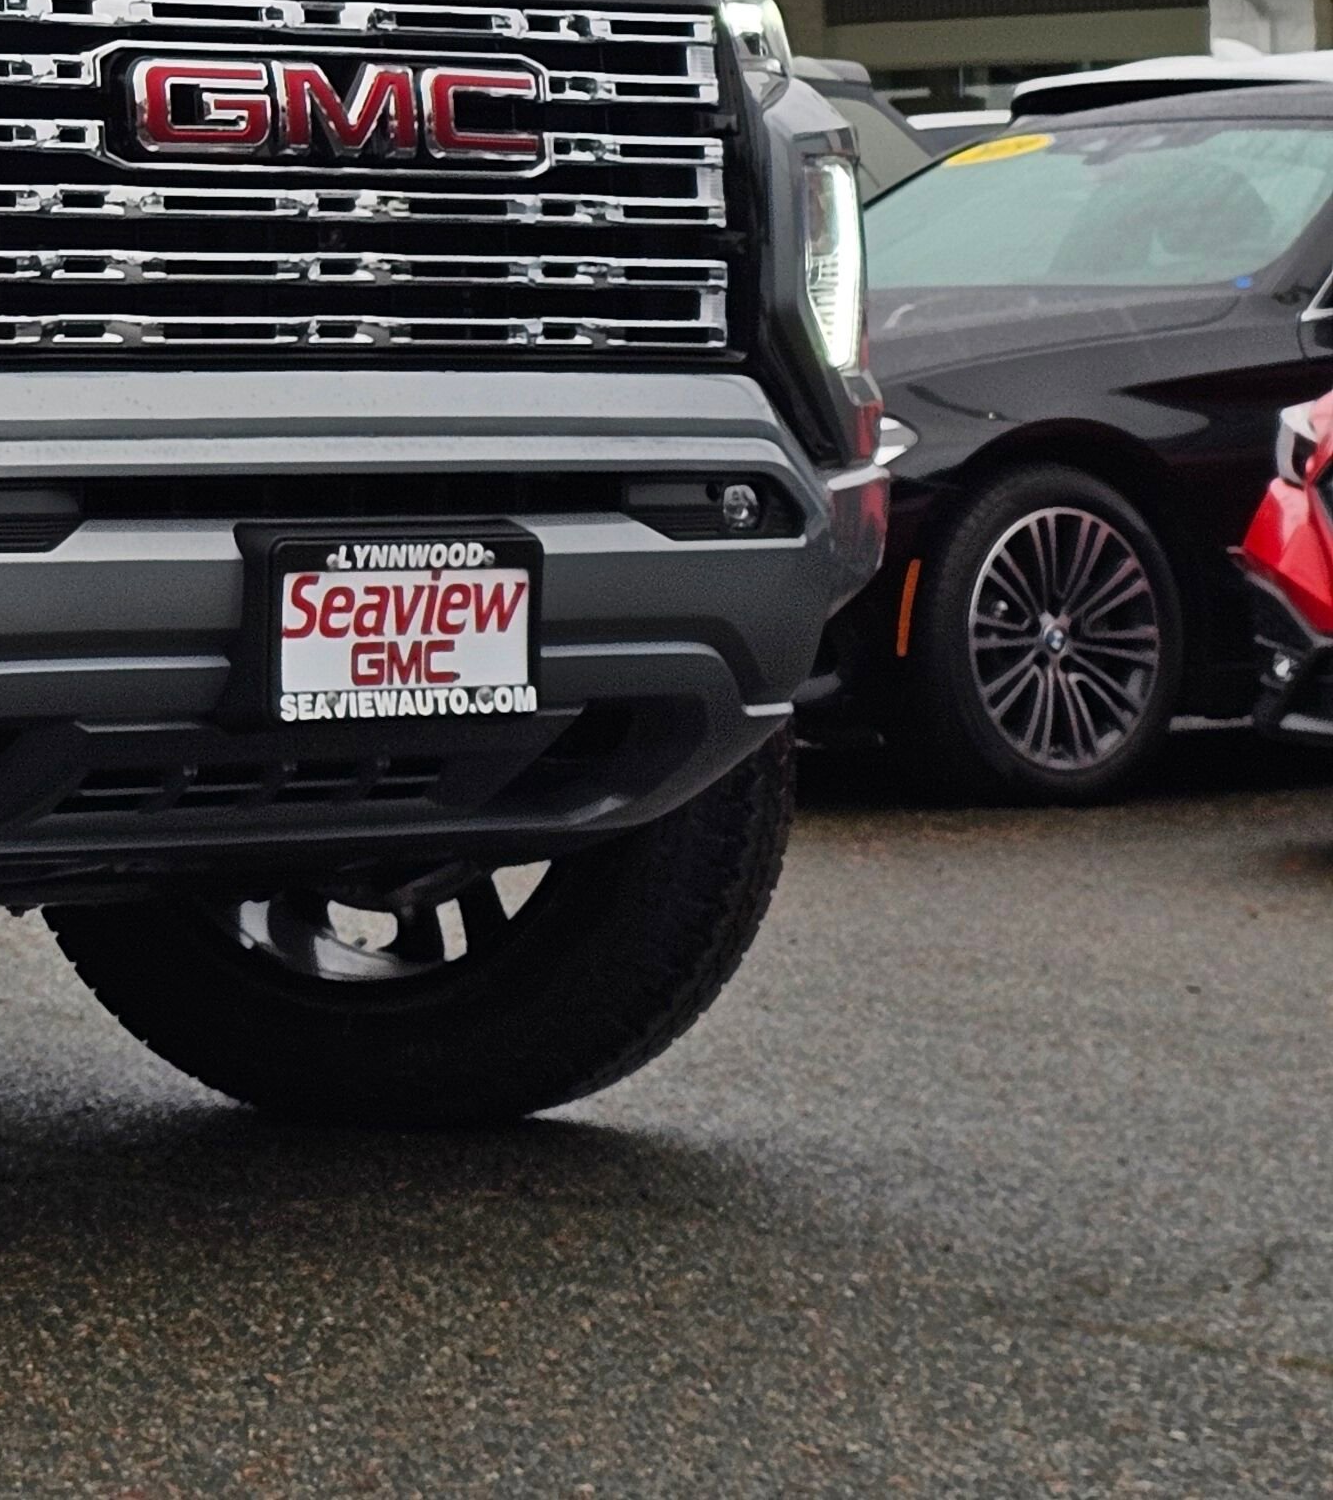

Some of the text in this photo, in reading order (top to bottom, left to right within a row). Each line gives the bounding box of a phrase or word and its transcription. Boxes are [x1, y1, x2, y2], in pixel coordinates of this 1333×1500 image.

[133, 58, 540, 160] GMC
[336, 542, 485, 569] LYNNWOOD
[282, 569, 527, 639] Seaview
[350, 639, 460, 687] GMC
[280, 685, 538, 722] SEAVIEWAUTO.COM
